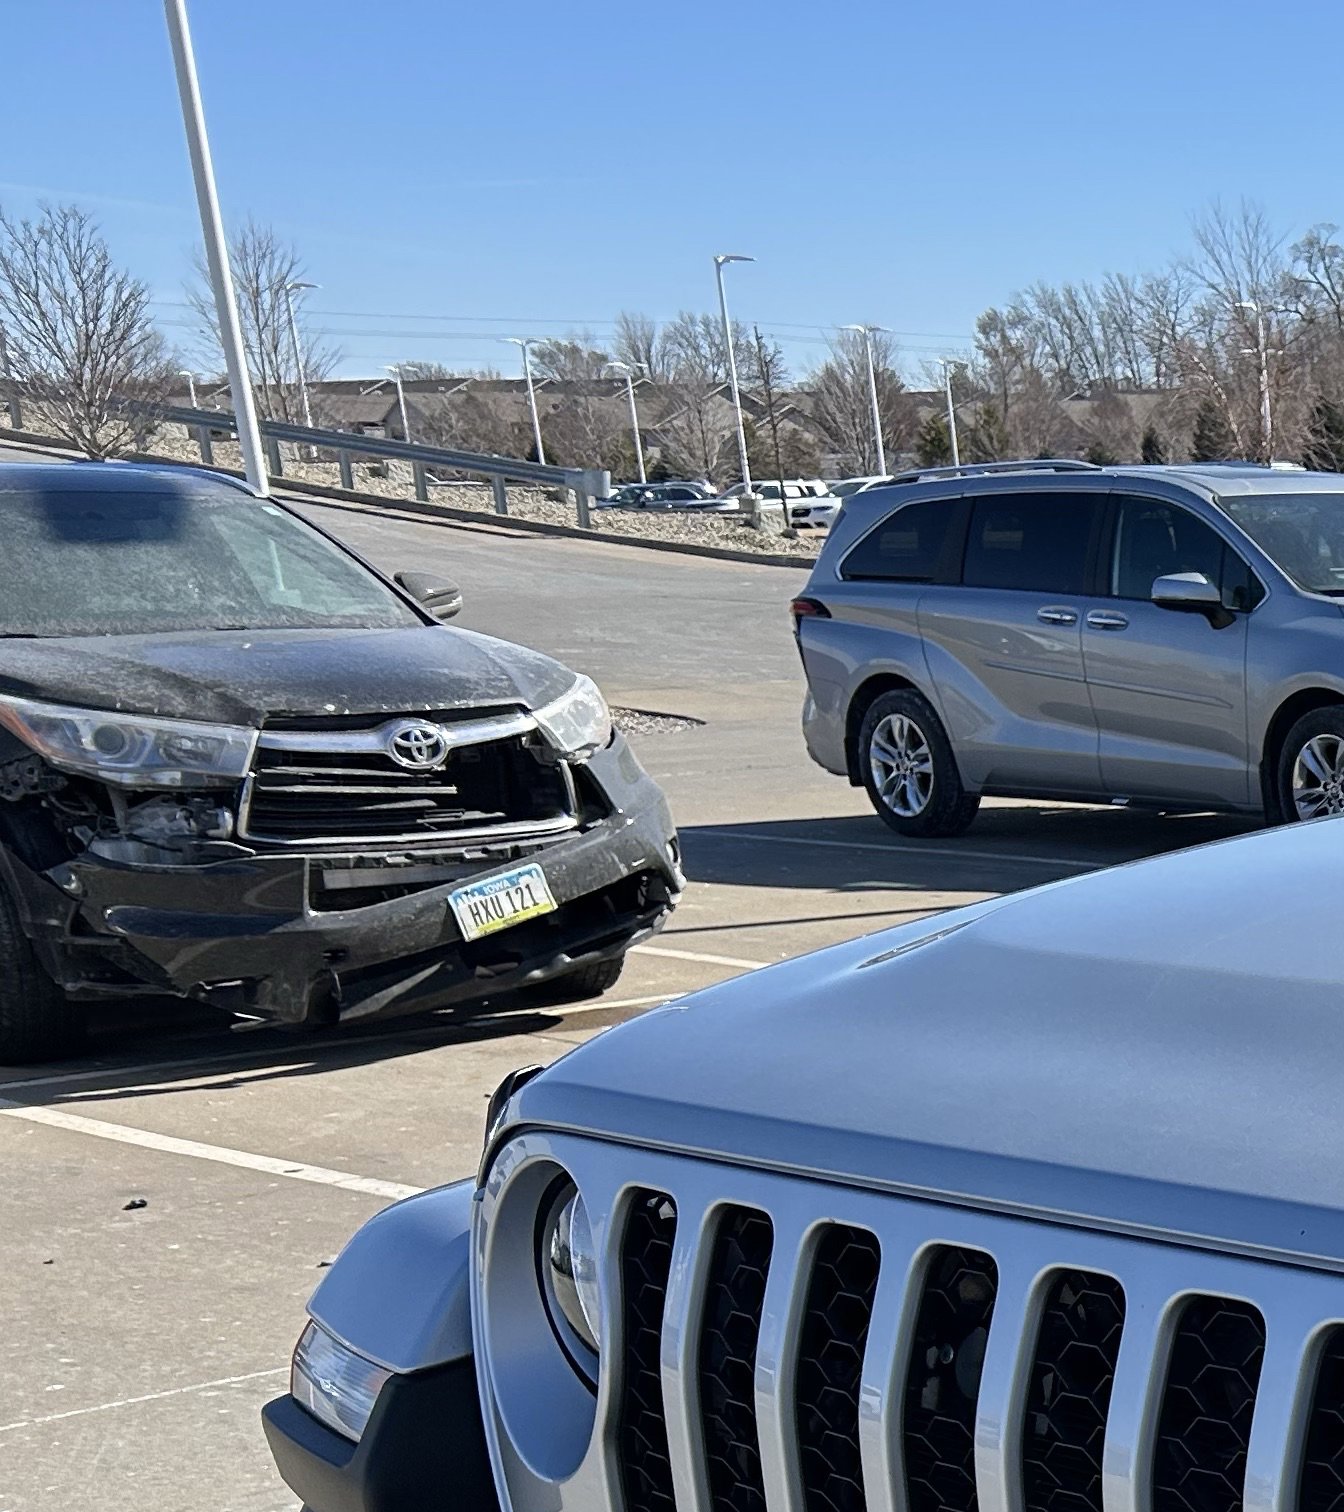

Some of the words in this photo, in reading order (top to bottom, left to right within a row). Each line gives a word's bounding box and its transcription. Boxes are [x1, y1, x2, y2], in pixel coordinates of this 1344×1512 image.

[483, 879, 511, 896] IOWA
[468, 894, 505, 928] HXU
[505, 883, 540, 914] 121
